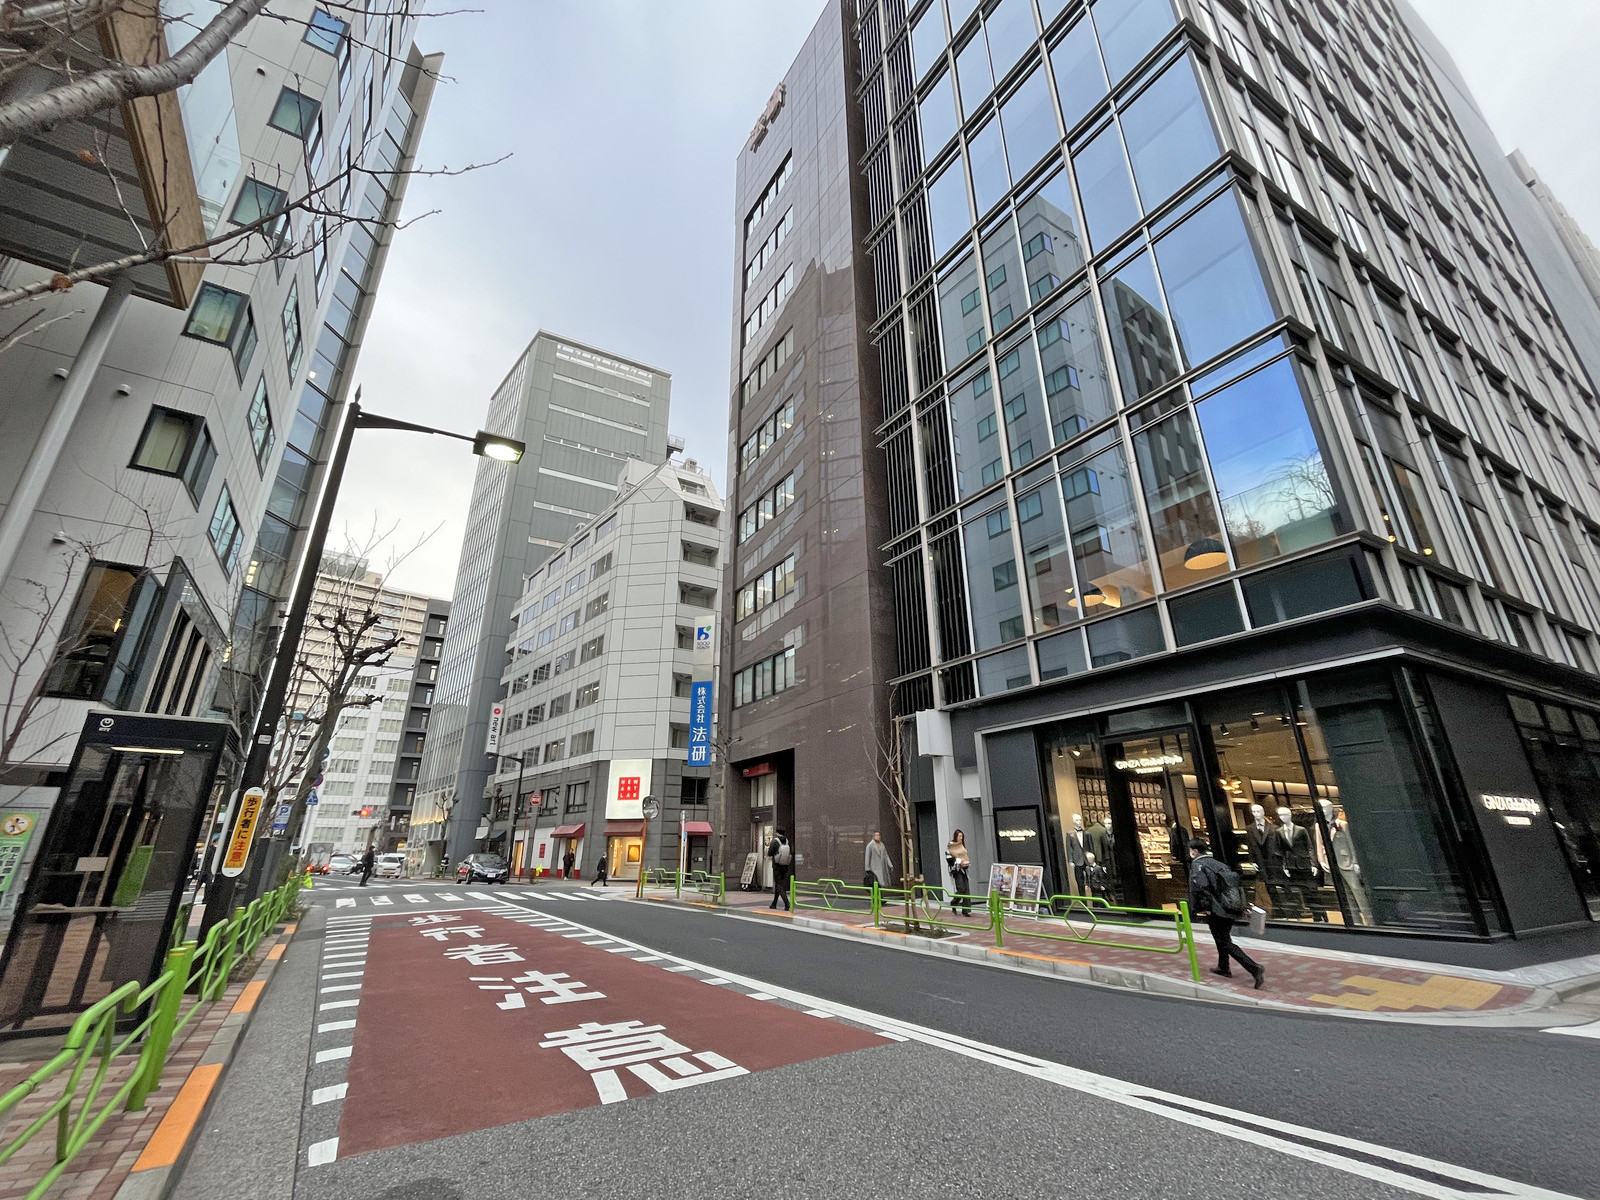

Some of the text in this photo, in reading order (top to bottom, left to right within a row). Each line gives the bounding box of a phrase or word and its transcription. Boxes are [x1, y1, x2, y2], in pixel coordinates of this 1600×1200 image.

[489, 717, 499, 746] new art
[1115, 755, 1183, 769] GINZA Global Style
[229, 797, 258, 862] 歩行者に注意
